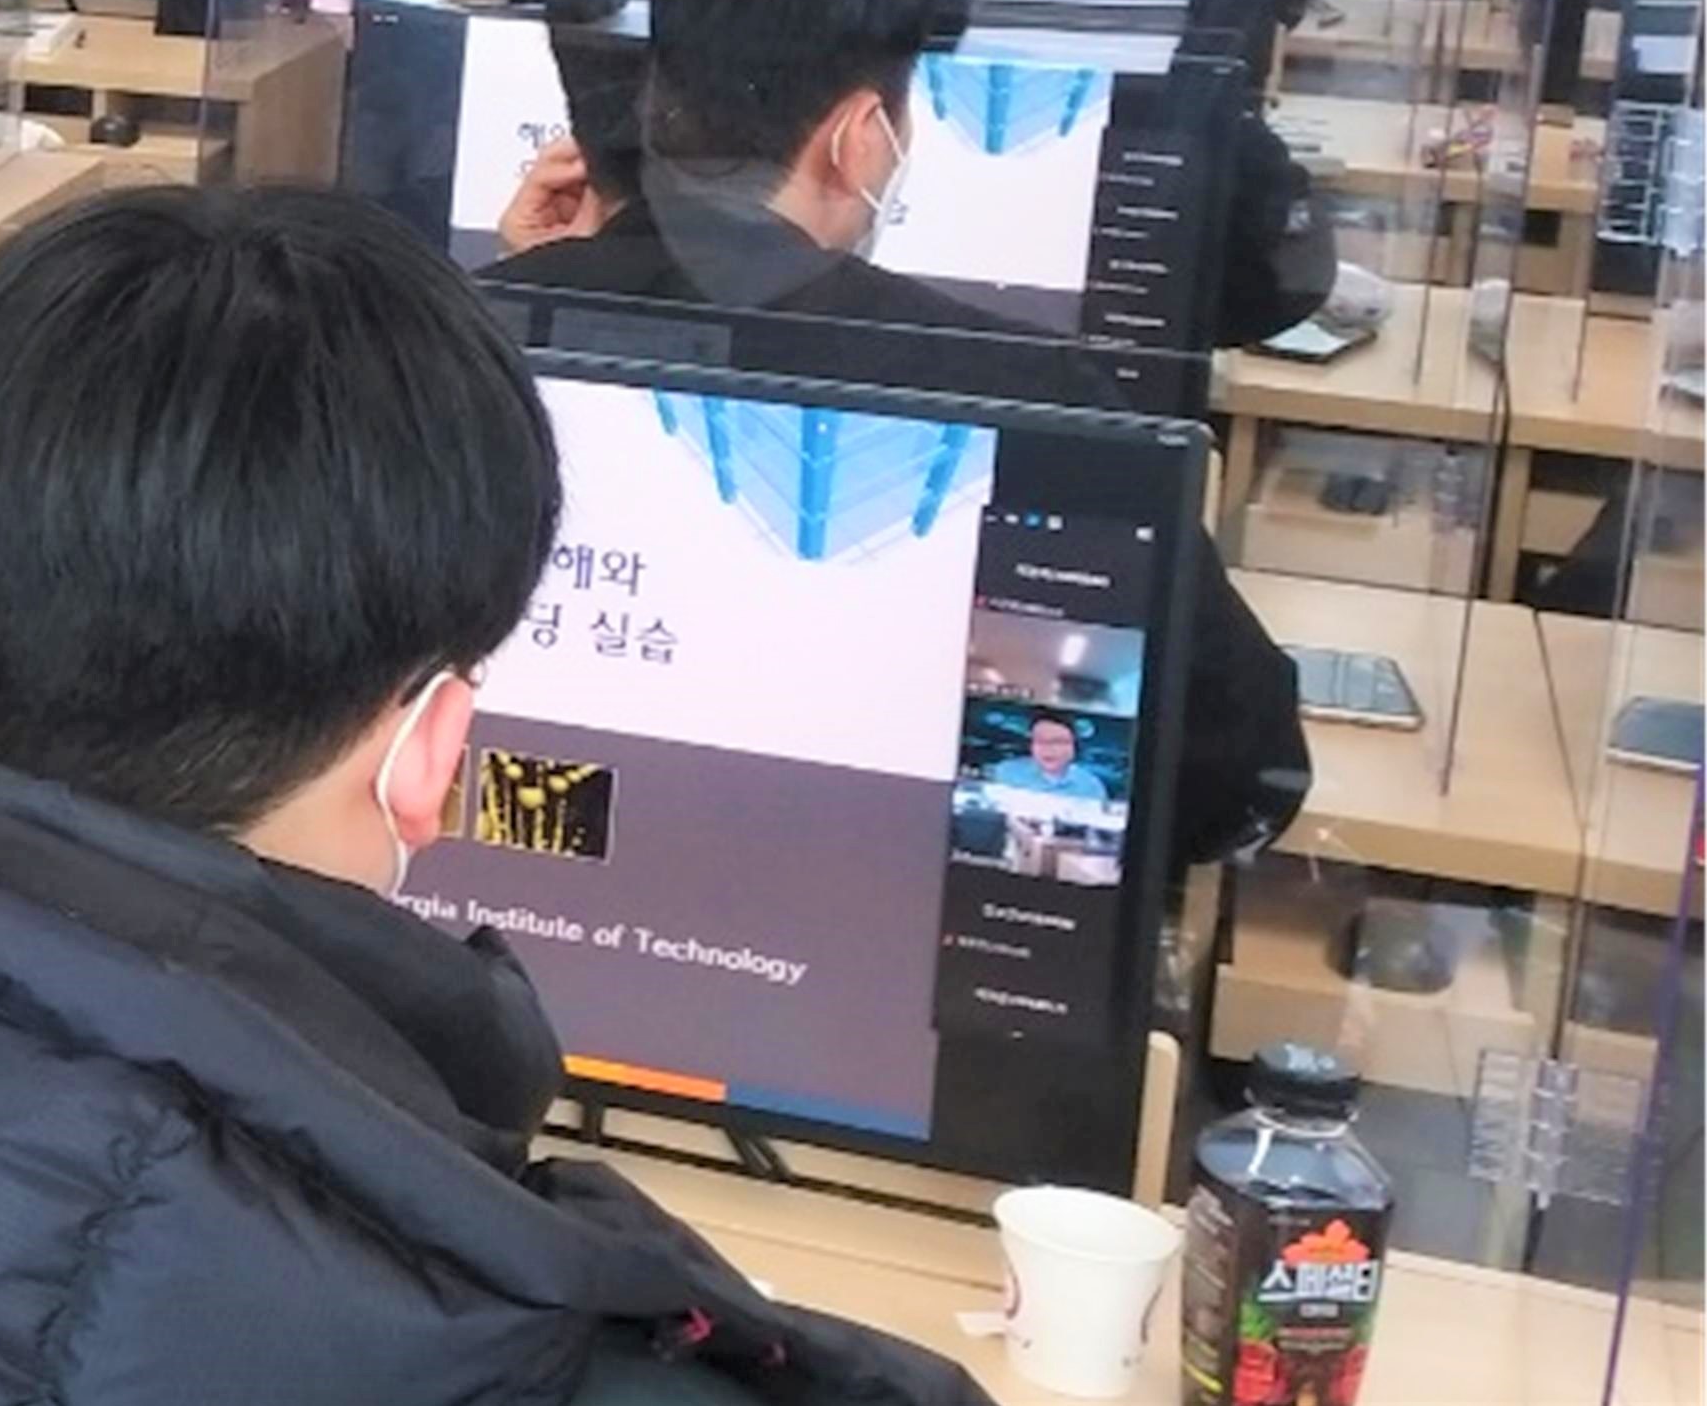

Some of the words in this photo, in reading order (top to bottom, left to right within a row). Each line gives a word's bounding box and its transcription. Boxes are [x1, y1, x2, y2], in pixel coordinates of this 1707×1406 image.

[589, 610, 680, 666] 실습
[467, 898, 586, 943] Institute
[592, 923, 628, 950] of
[632, 926, 809, 985] Technology
